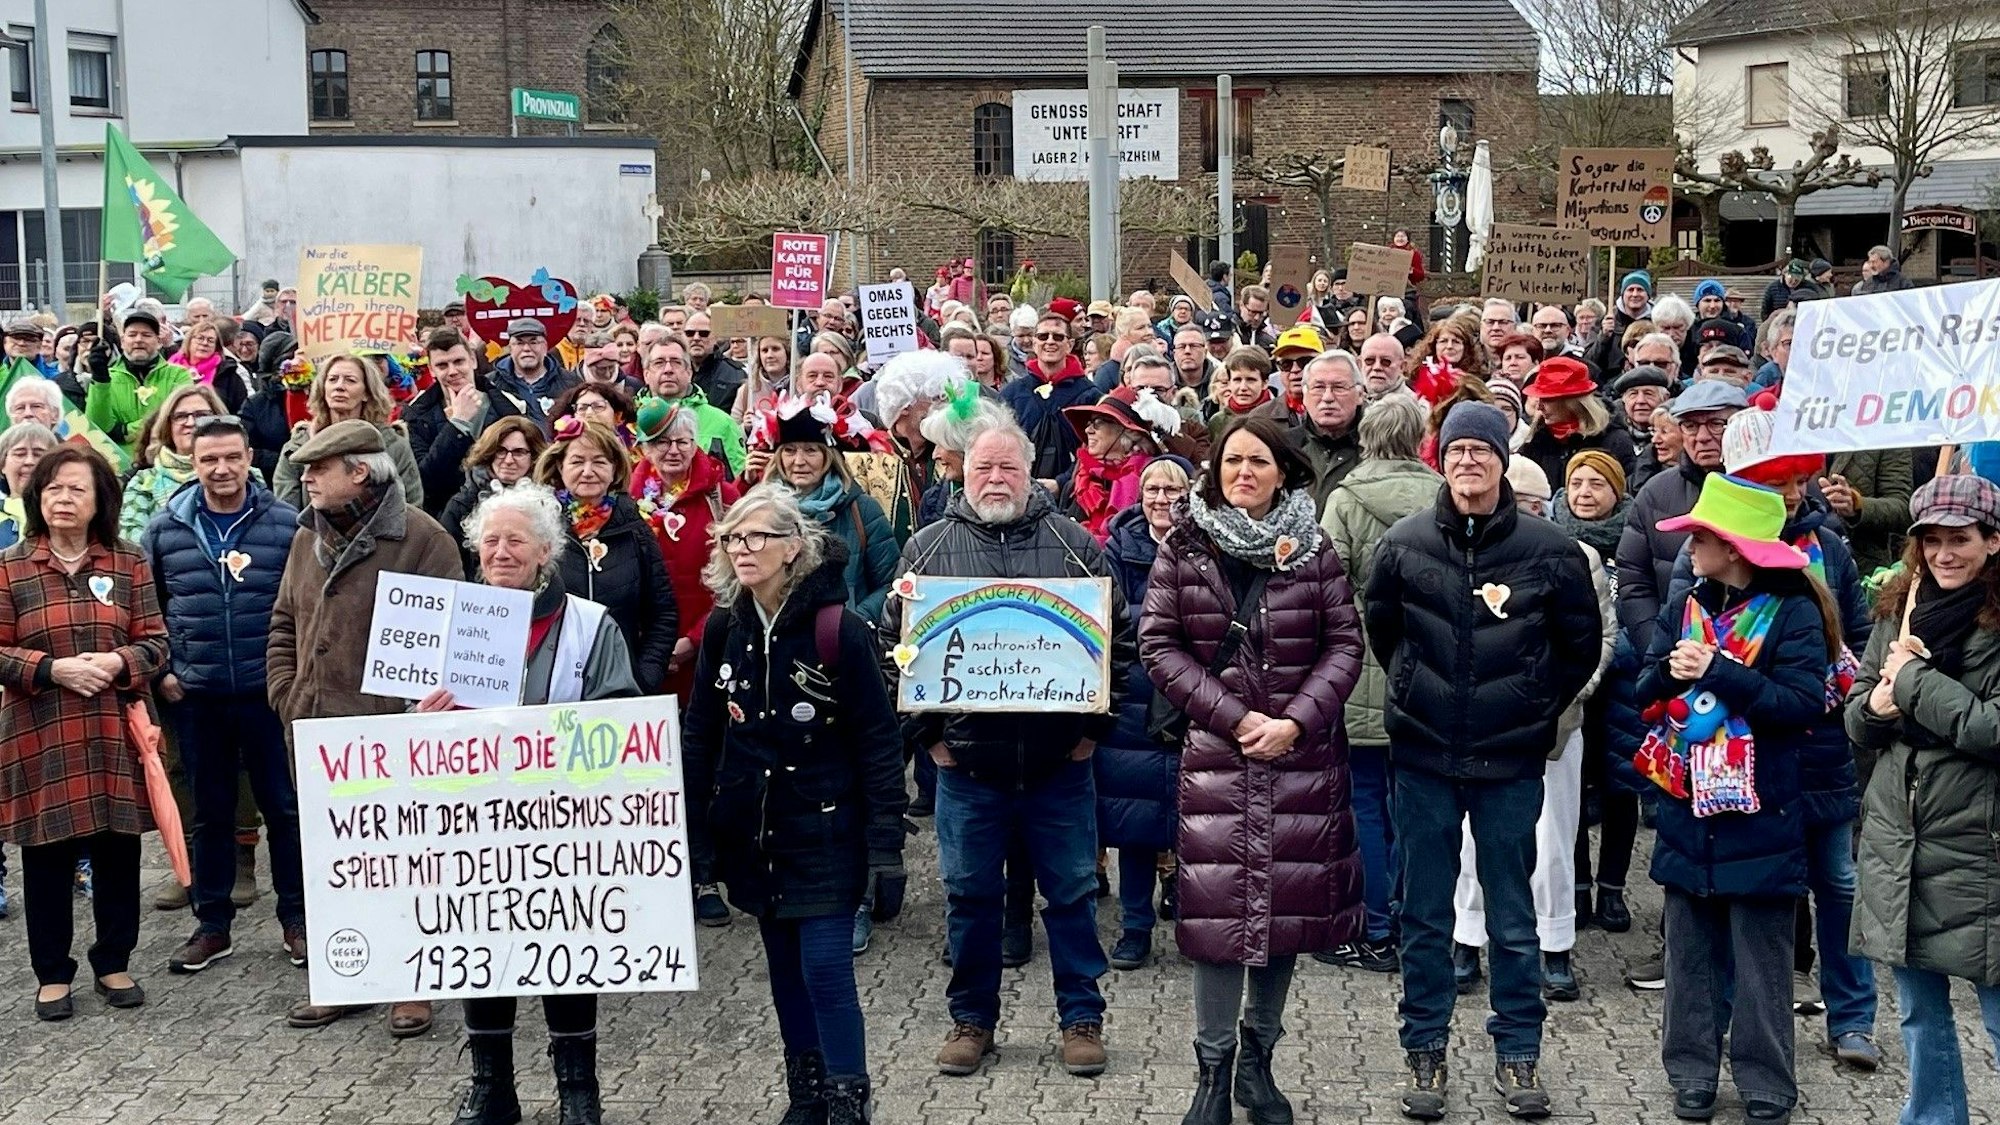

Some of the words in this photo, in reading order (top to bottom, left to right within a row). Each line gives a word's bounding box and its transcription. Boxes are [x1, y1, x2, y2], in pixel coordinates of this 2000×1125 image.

[522, 91, 576, 118] PROVINZIAL
[1031, 103, 1162, 120] GENOSSCHAFT
[1032, 152, 1067, 164] LAGER
[1070, 153, 1077, 163] 2
[1570, 155, 1620, 179] Sogar
[1627, 160, 1645, 172] die
[1569, 177, 1626, 197] Kartoffel
[1628, 179, 1647, 192] hat
[1565, 199, 1629, 222] Migrations
[1909, 215, 1962, 227] Biergarten
[1491, 224, 1501, 239] In
[306, 249, 326, 259] Nur
[329, 248, 348, 259] die
[782, 239, 818, 251] ROTE
[777, 253, 822, 265] KARTE
[1537, 262, 1565, 274] Platz
[785, 265, 812, 279] FÜR
[316, 271, 411, 298] KÄLBER
[777, 279, 819, 292] NAZIS
[1488, 276, 1512, 293] Für
[868, 289, 903, 303] OMAS
[303, 298, 355, 316] wählen
[365, 298, 405, 313] ihren
[867, 306, 908, 320] GEGEN
[303, 312, 417, 346] METZGER
[867, 323, 914, 338] RECHTS
[352, 338, 397, 351] selber
[1810, 323, 1925, 364] Gegen
[1793, 396, 1847, 431] für
[388, 587, 446, 612] Omas
[461, 601, 485, 615] Wer
[487, 607, 510, 619] AfD
[913, 614, 940, 639] WIR
[949, 585, 1043, 616] BRAUCHEN
[1051, 597, 1097, 634] KEINE
[379, 627, 441, 650] gegen
[457, 626, 491, 642] wählt,
[453, 650, 485, 664] wählt
[488, 653, 506, 668] die
[372, 659, 440, 687] Rechts
[450, 672, 510, 692] DIKTATUR
[914, 684, 927, 702] &
[409, 734, 501, 777] KLAGEN
[567, 722, 619, 773] AfD
[621, 719, 672, 767] AN!
[328, 804, 389, 841] WER
[436, 802, 478, 836] DEM
[453, 840, 682, 887] DEUTSCHLANDS
[415, 885, 627, 935] UNTERGANG
[335, 934, 358, 945] OMAS
[331, 947, 364, 958] GEGEN
[334, 958, 366, 969] RECHTS
